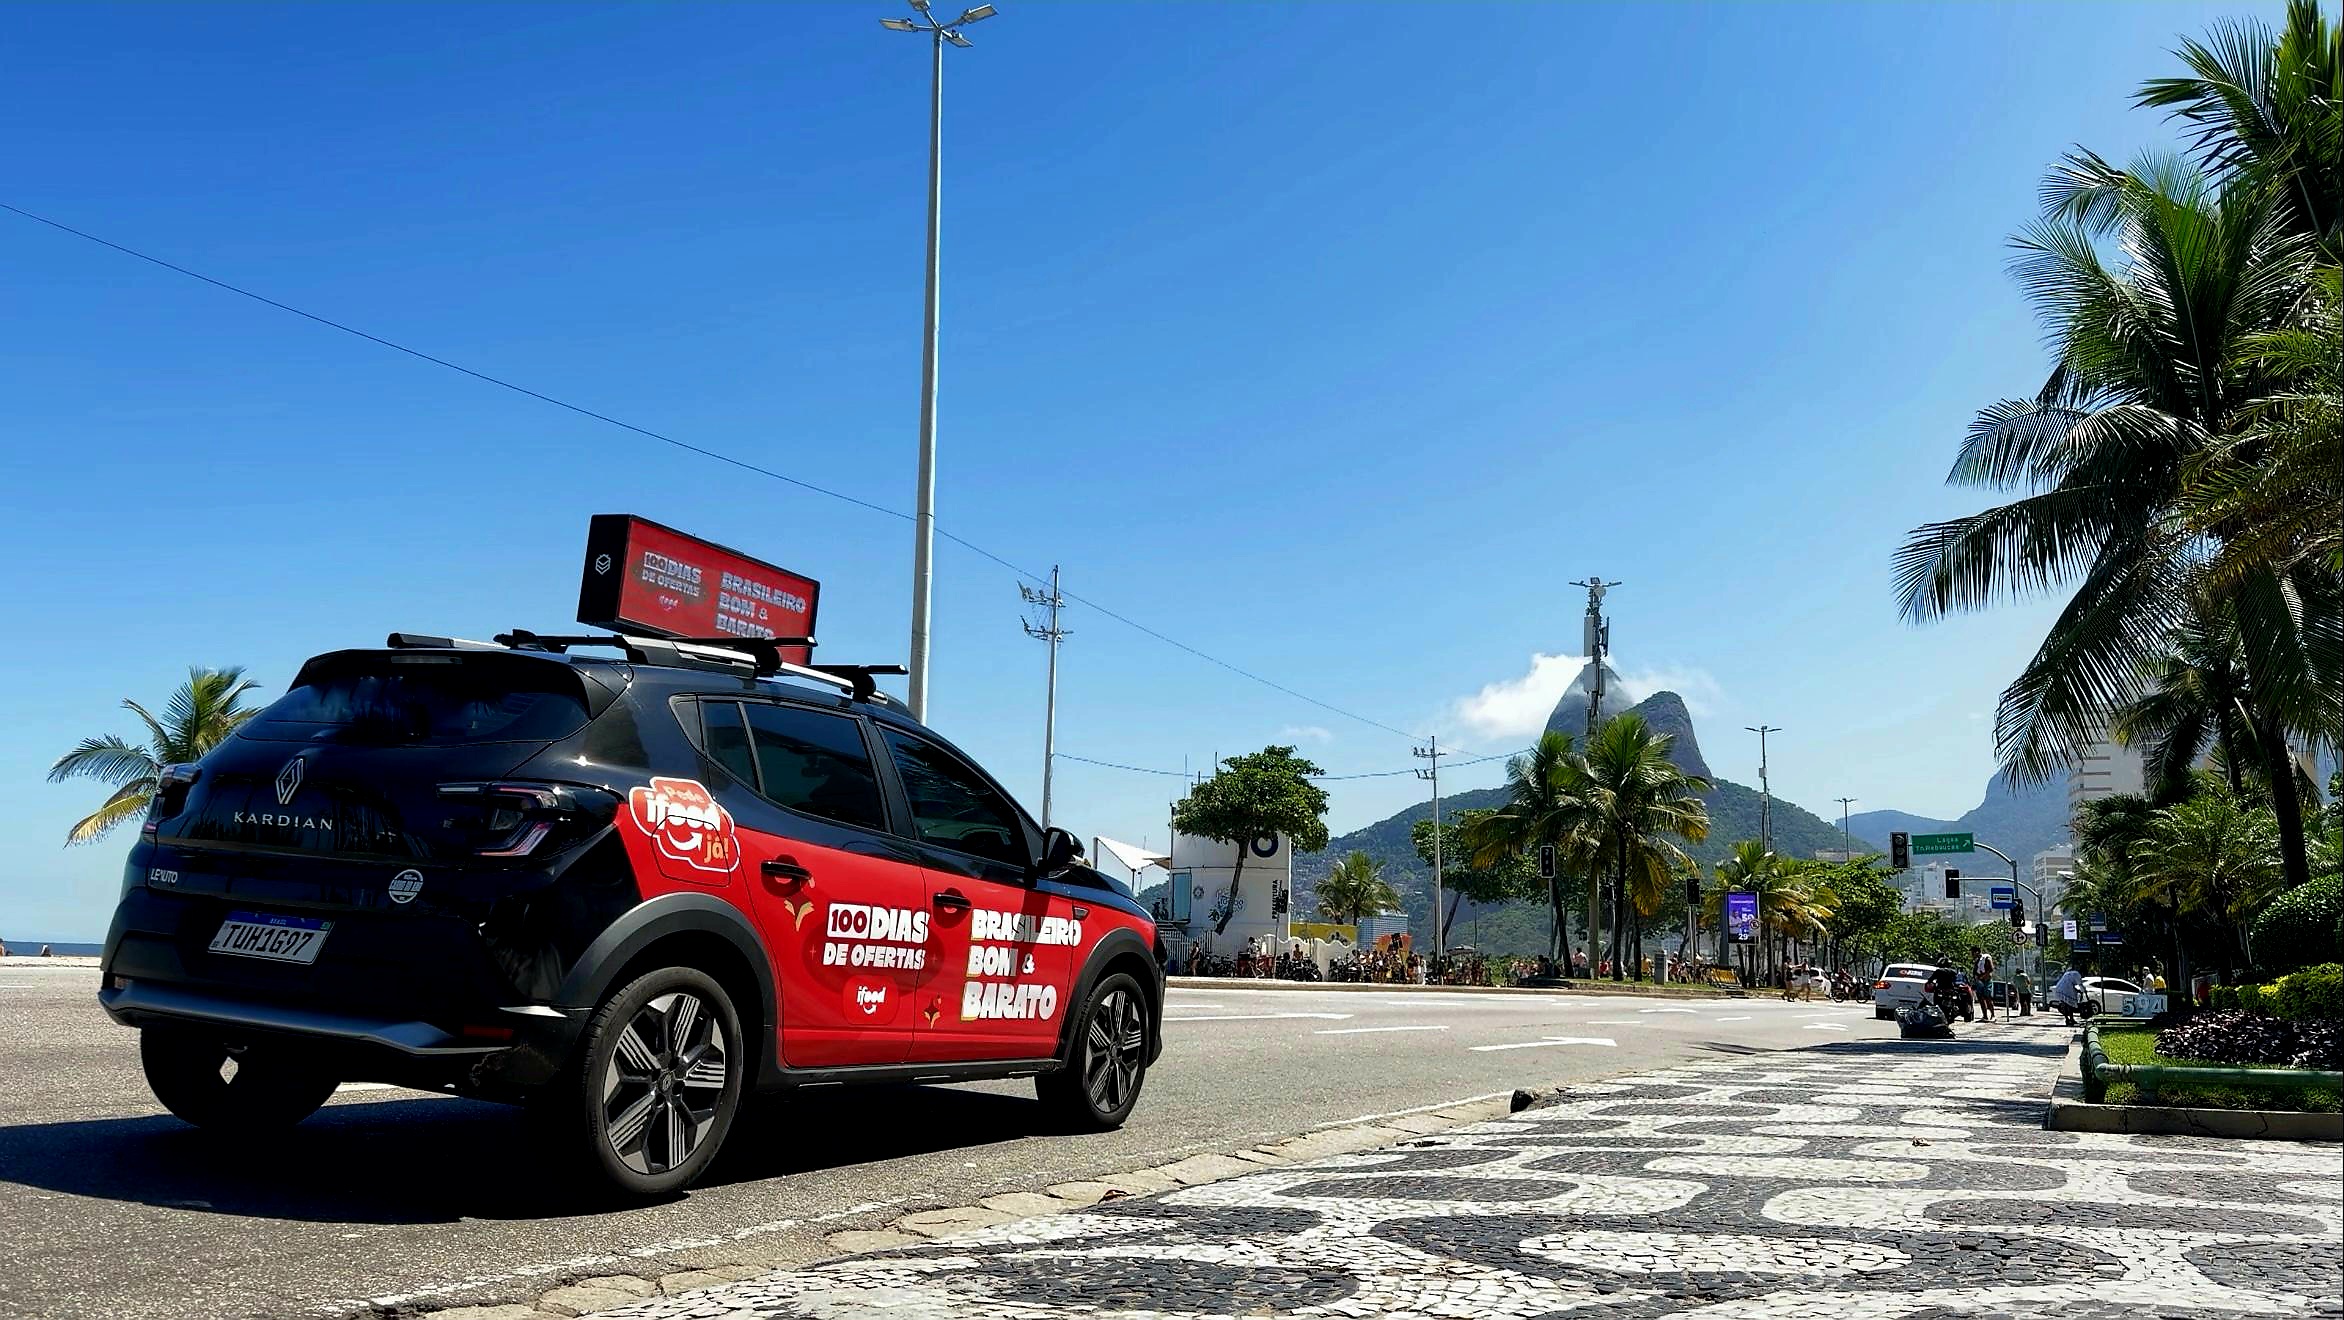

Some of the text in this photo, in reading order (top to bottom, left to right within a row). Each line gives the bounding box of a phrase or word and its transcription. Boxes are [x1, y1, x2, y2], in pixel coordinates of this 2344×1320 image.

[642, 569, 700, 598] DE OFERTAS
[667, 559, 702, 584] DIAS
[719, 592, 768, 620] BOM &
[721, 572, 806, 614] BRASILEIRO
[234, 811, 333, 831] KARDIAN
[222, 924, 315, 956] TUH1G97
[831, 906, 930, 944] 100 DIAS
[971, 908, 1082, 947] BRASILEIRO
[823, 942, 926, 970] DE OFERTAS
[966, 945, 1035, 978] BOM &
[856, 985, 887, 1006] ifood
[961, 981, 1057, 1021] BARATO
